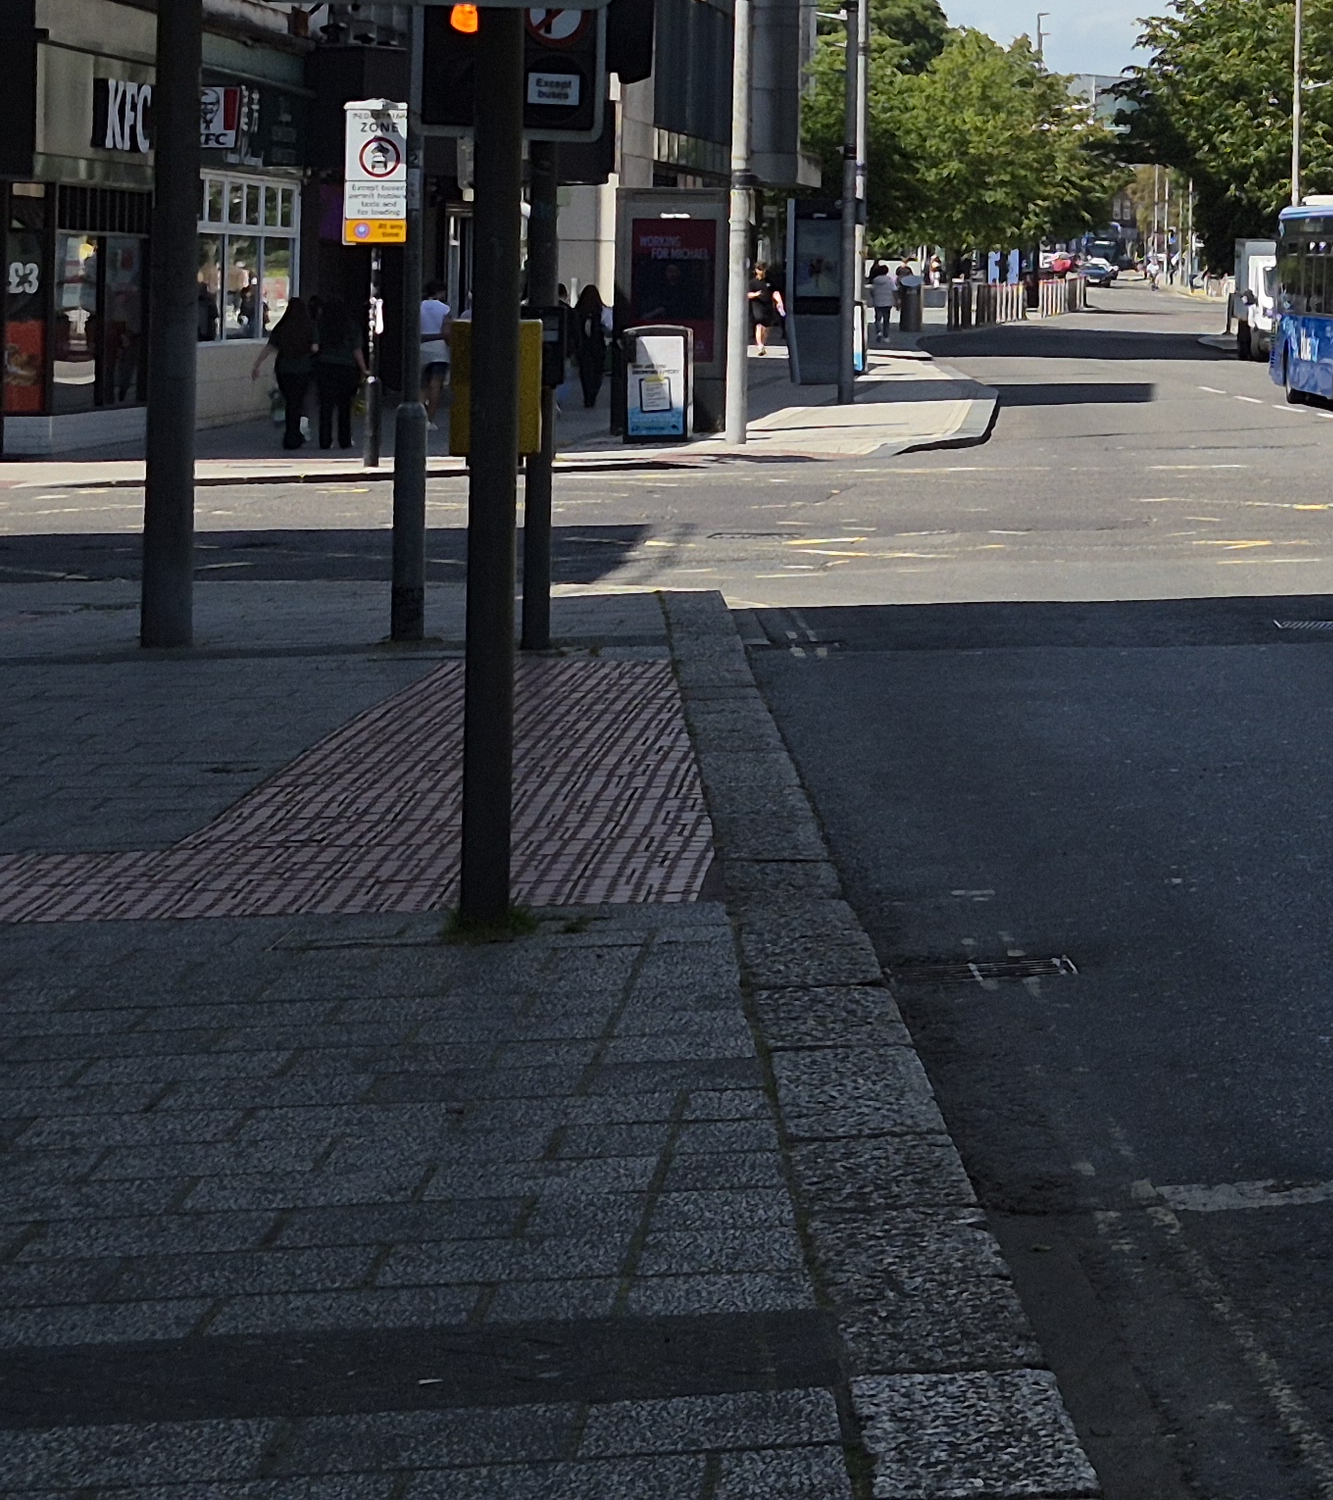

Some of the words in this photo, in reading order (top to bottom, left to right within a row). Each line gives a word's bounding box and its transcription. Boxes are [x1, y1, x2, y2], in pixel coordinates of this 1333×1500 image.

[536, 78, 572, 90] Except
[105, 78, 152, 153] KFC
[361, 122, 399, 133] ZONE
[201, 133, 227, 146] FC
[8, 261, 39, 294] £3
